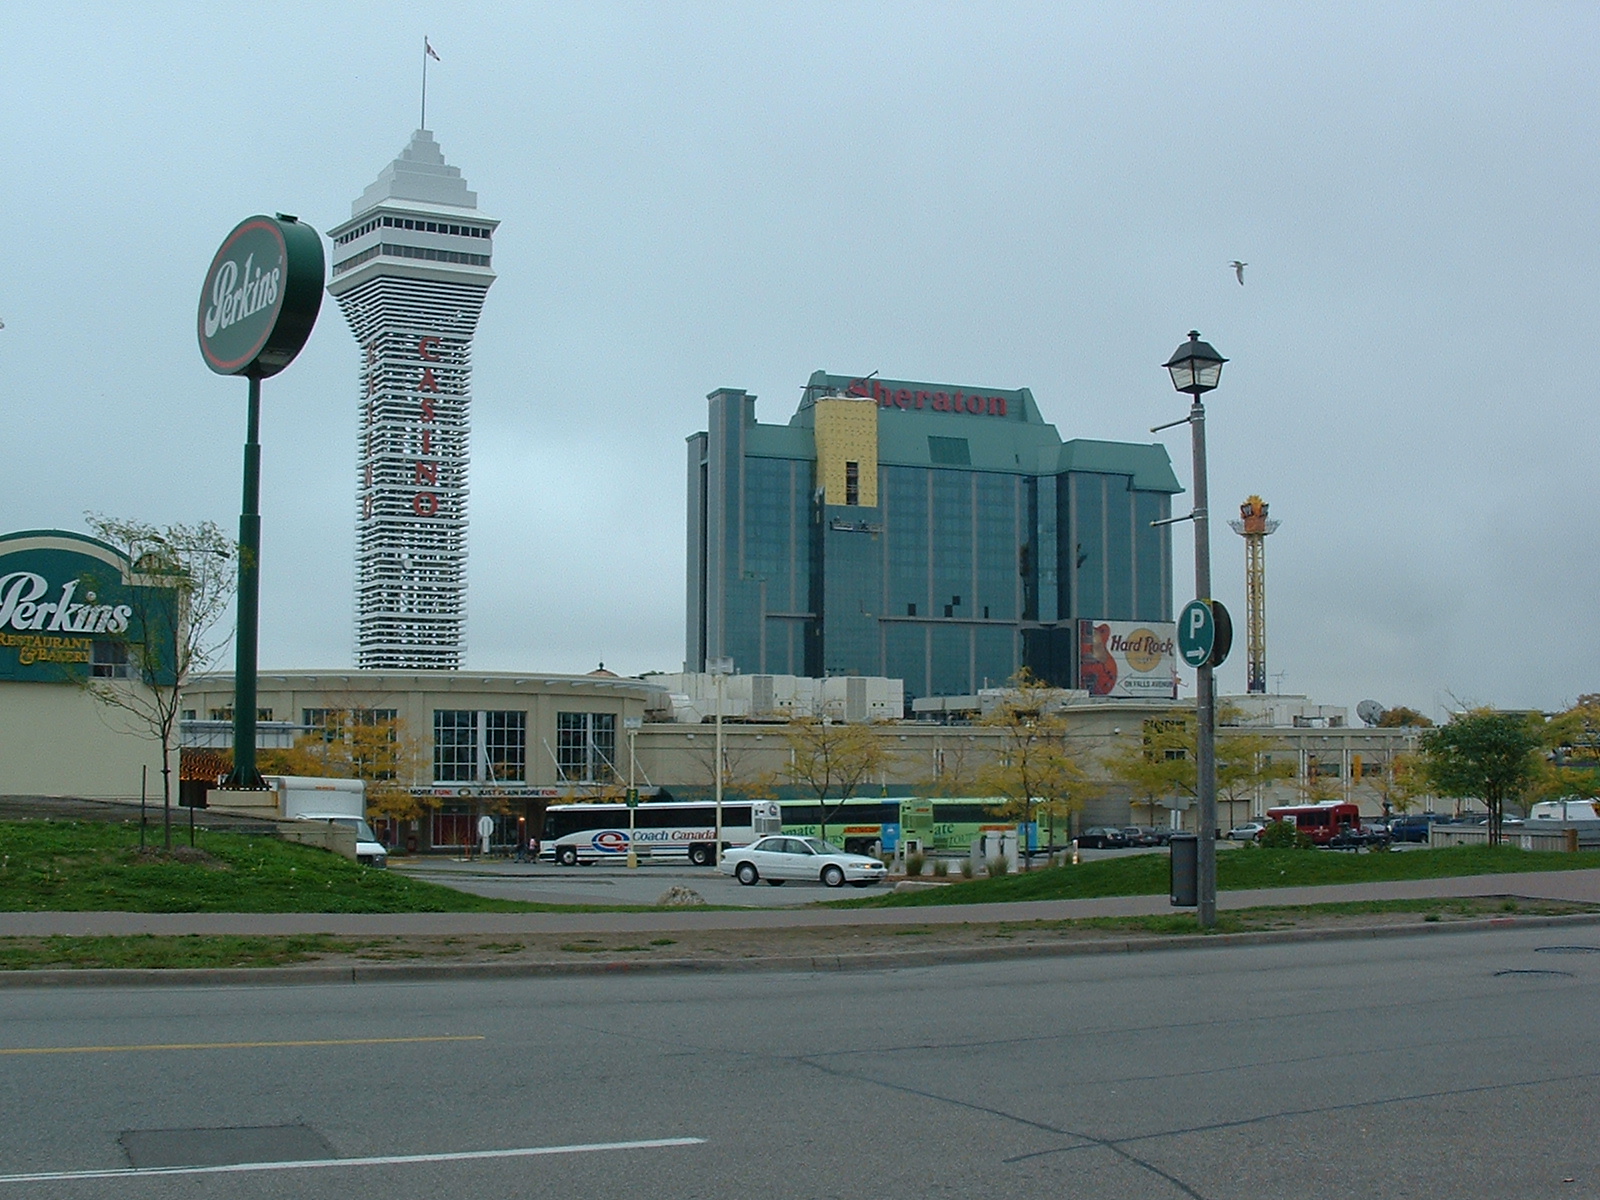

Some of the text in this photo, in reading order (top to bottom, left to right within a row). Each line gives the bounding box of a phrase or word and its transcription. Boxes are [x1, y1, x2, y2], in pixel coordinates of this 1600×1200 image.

[204, 252, 280, 338] Perkins
[847, 376, 1008, 416] Sheraton
[411, 336, 440, 517] CASINO
[0, 571, 133, 634] Perkins
[1189, 608, 1205, 639] P
[0, 633, 93, 650] RESTAURANT
[1110, 635, 1174, 656] Hard Rock
[632, 829, 717, 842] Coach Canada
